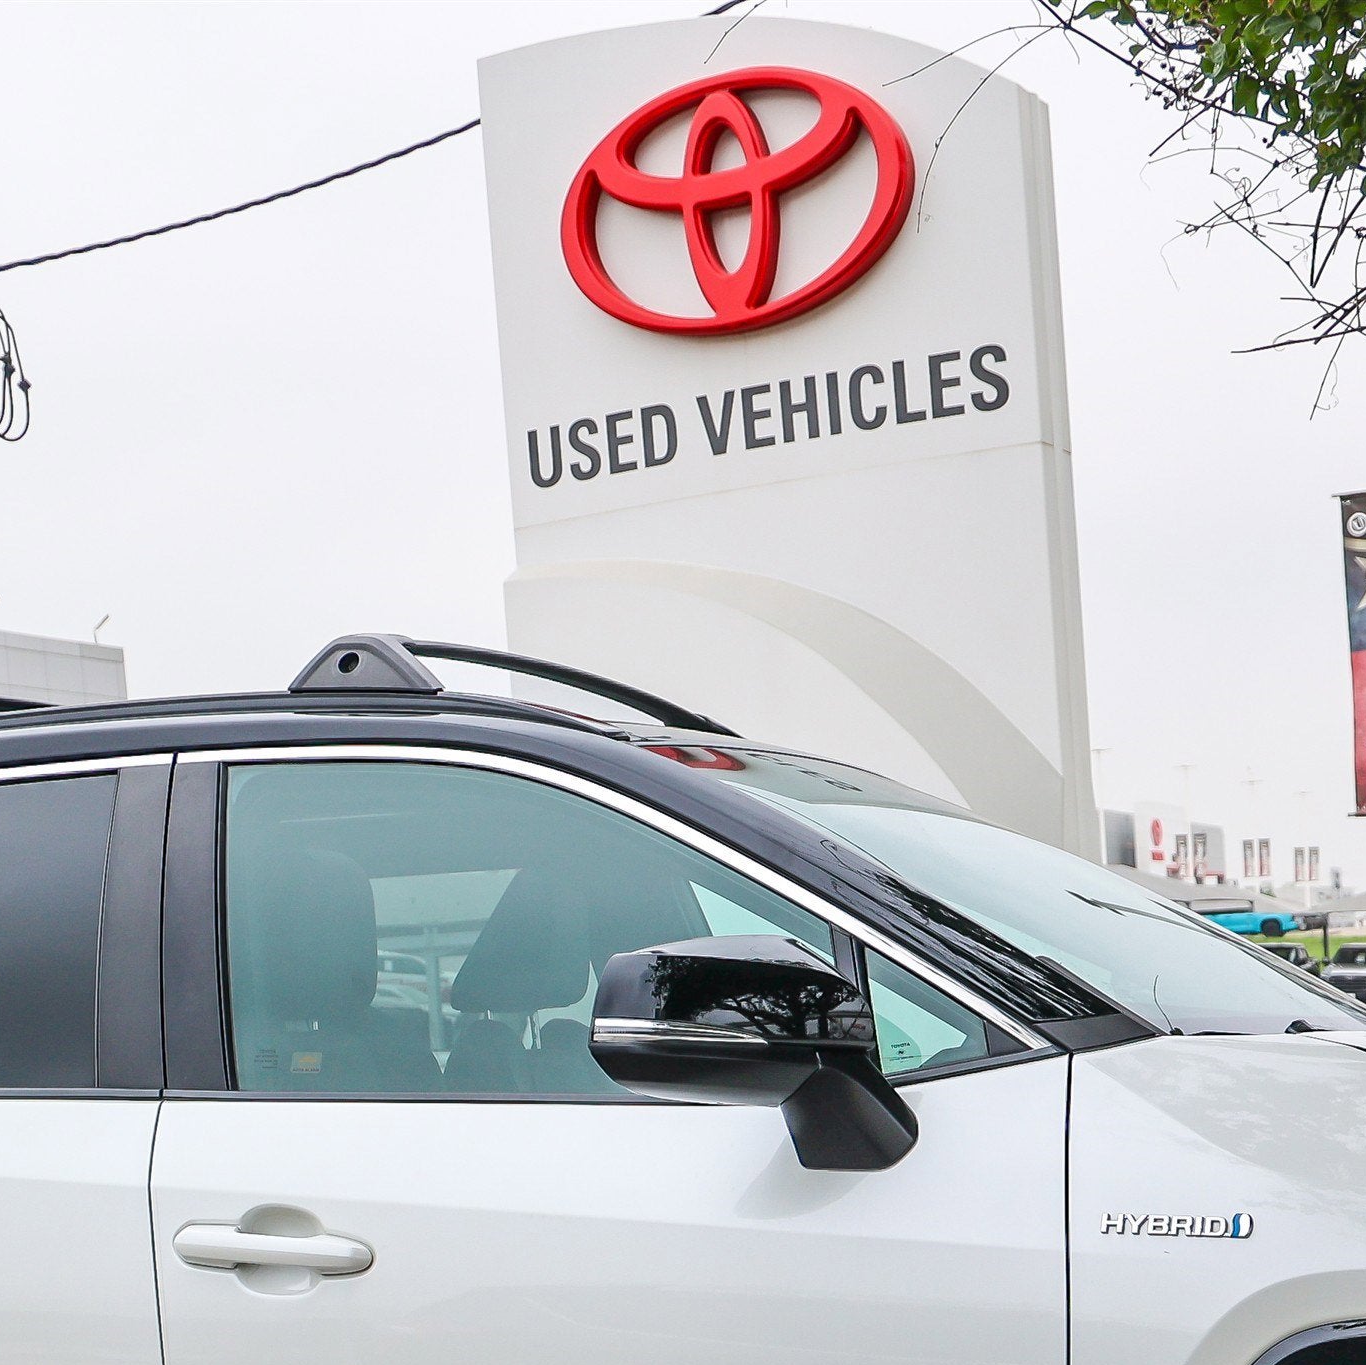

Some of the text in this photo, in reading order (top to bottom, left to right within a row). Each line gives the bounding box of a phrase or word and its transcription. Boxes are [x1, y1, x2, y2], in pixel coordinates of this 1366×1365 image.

[527, 343, 1011, 489] USED VEHICLES
[1100, 1212, 1228, 1237] HYBRID
